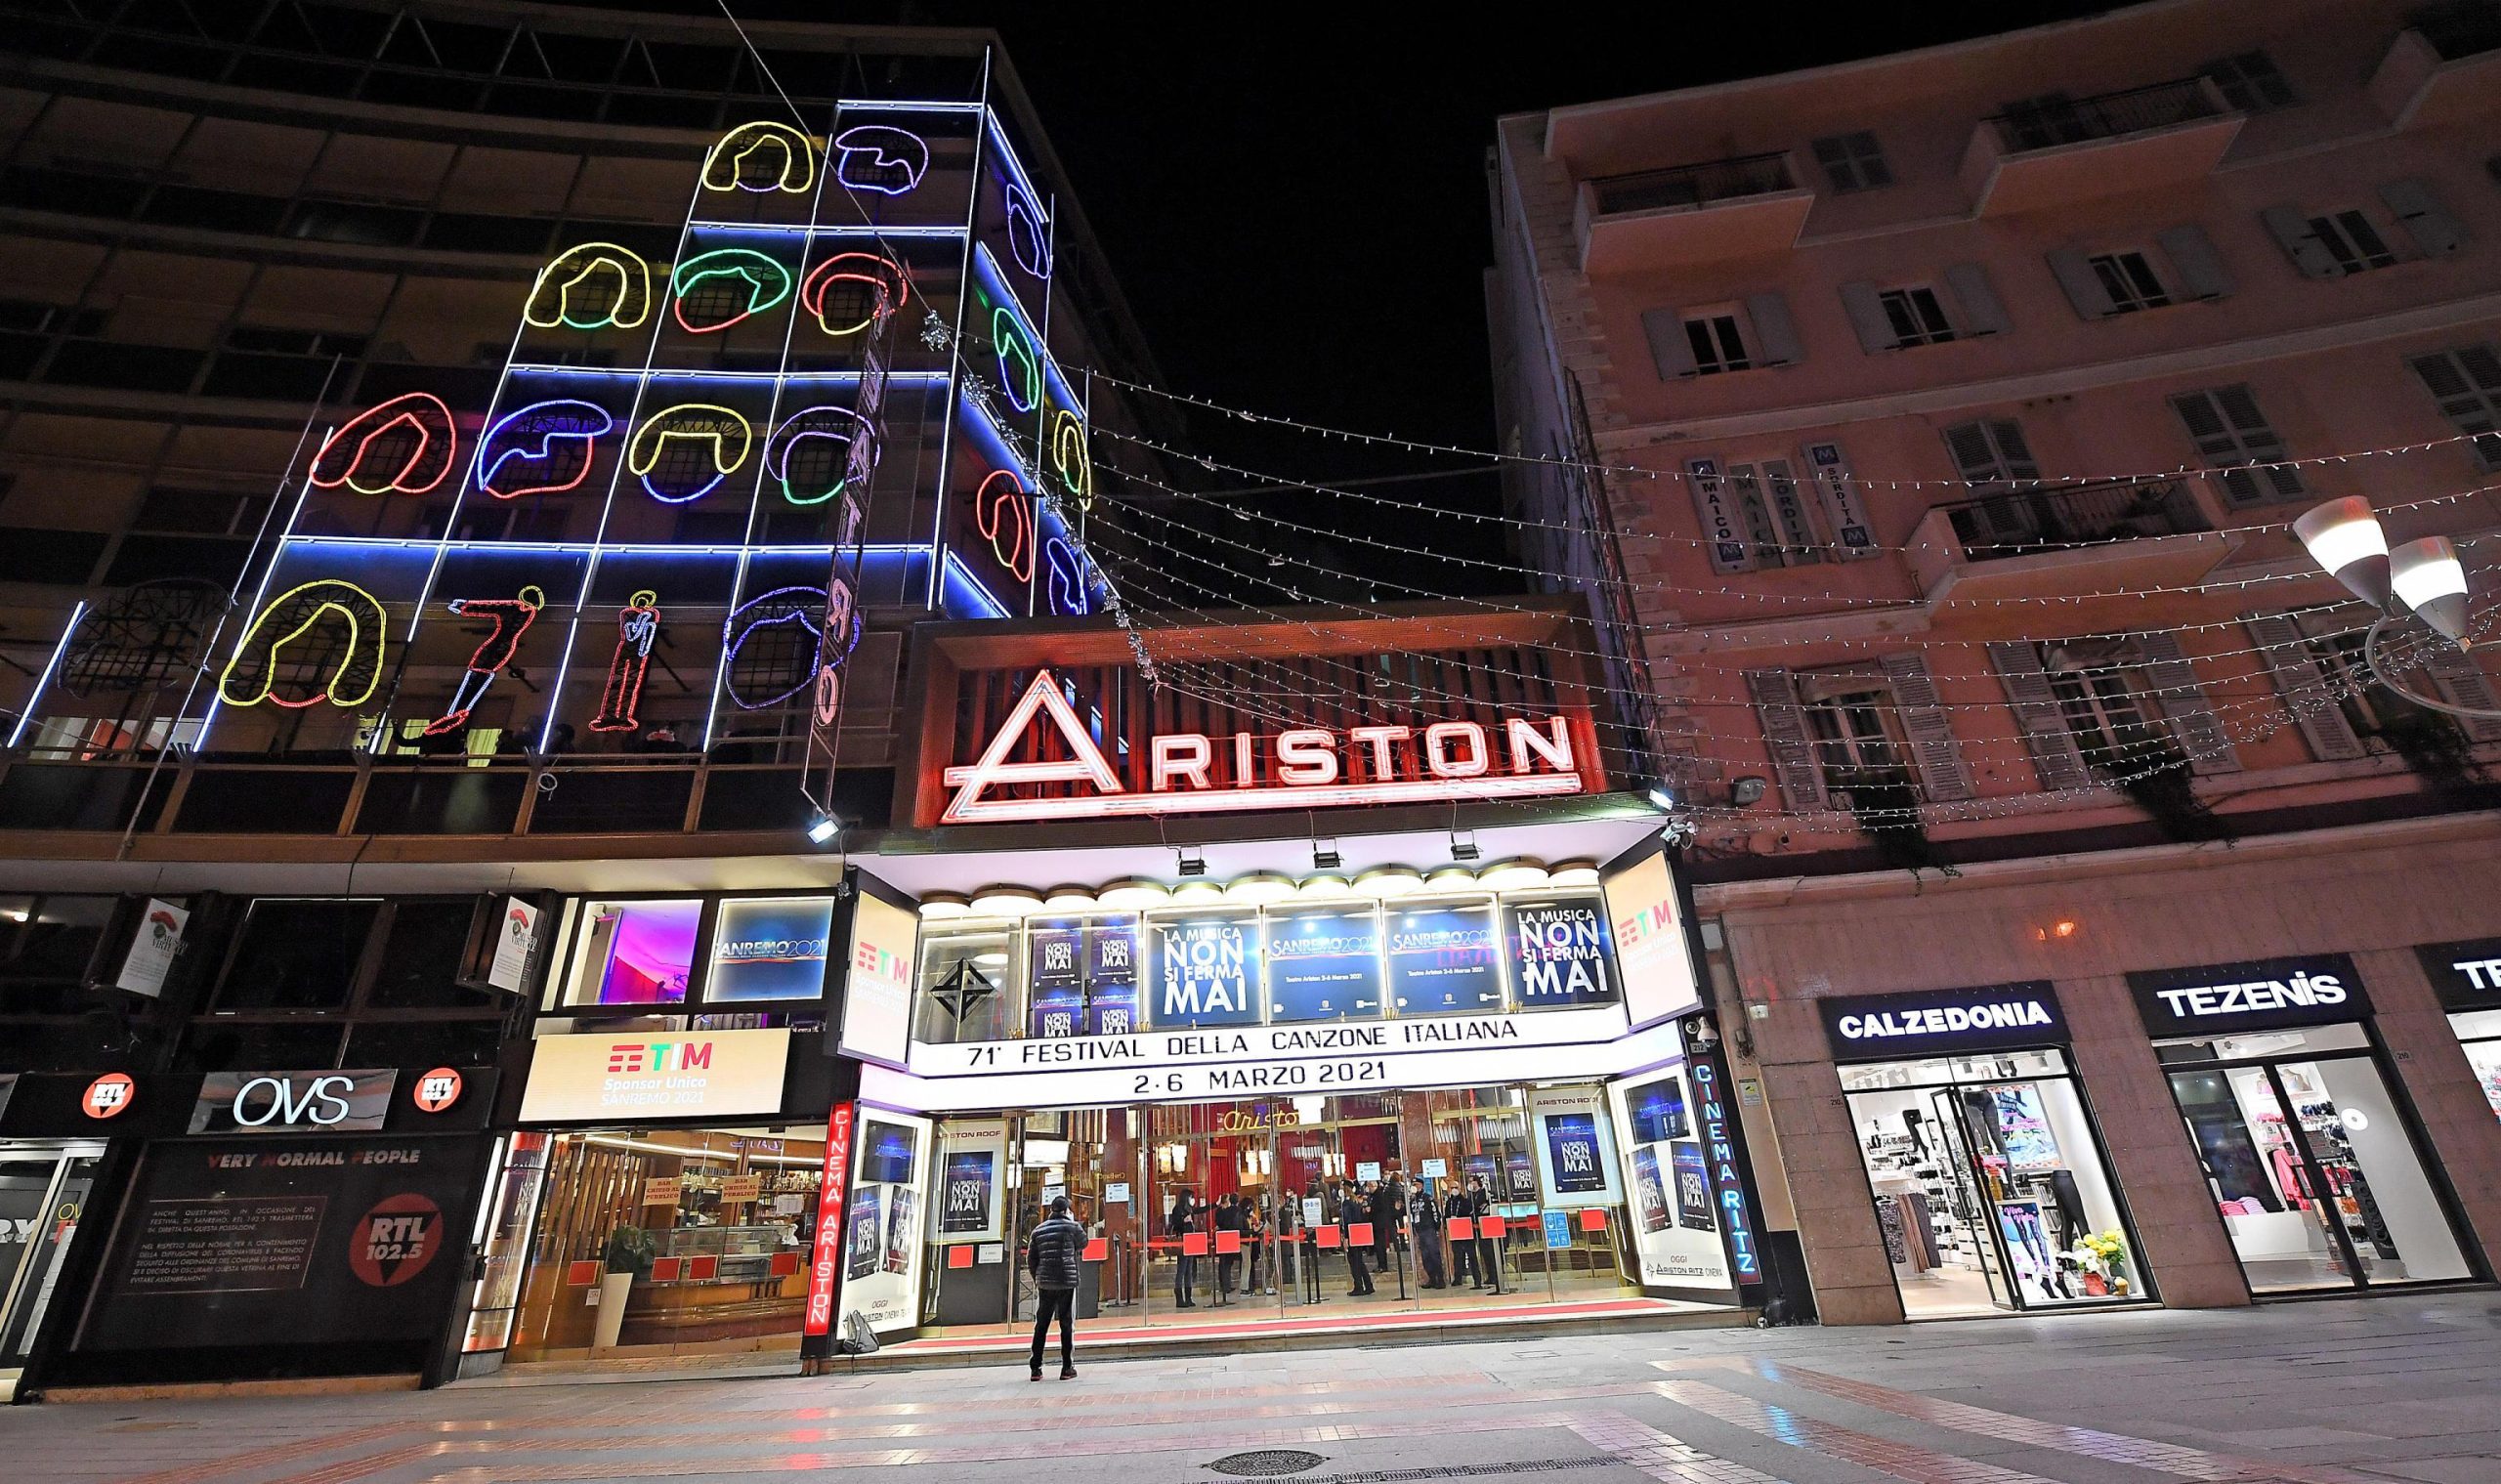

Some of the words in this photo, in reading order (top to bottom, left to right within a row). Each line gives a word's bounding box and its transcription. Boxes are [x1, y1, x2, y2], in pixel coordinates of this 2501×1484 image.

[1827, 467, 1855, 526] SORDITA
[1702, 482, 1731, 539] MAICO
[941, 668, 1582, 824] ARISTON
[1517, 911, 1540, 925] LA
[1542, 908, 1595, 922] MUSICA
[1635, 899, 1672, 937] TIM
[1163, 930, 1184, 943] LA
[1185, 926, 1243, 940] MUSICA
[1520, 920, 1600, 949] NON
[1045, 946, 1072, 956] NON
[1102, 943, 1128, 954] NON
[1163, 940, 1245, 967] NON
[1522, 948, 1540, 962] SI
[1542, 946, 1602, 961] FERMA
[878, 949, 909, 985] TIM
[1044, 956, 1072, 970] MAI
[1102, 954, 1128, 967] MAI
[1164, 966, 1183, 982] SI
[1183, 964, 1245, 980] FERMA
[1524, 960, 1608, 996] MAI
[1163, 978, 1247, 1015] MAI
[1044, 1015, 1072, 1026] NON
[1102, 1012, 1128, 1023] NON
[1839, 1000, 2053, 1039] CALZEDONIA
[1023, 1039, 1145, 1064] FESTIVAL
[1167, 1035, 1249, 1056] DELLA
[1272, 1026, 1386, 1051] CANZONE
[1404, 1019, 1518, 1043] ITALIANA
[649, 1041, 713, 1072] TIM
[603, 1077, 661, 1092] Sponsor
[665, 1075, 707, 1089] Unico
[1209, 1066, 1306, 1089] MARZO
[1319, 1061, 1385, 1082] 2021
[423, 1077, 458, 1092] RTL
[233, 1076, 354, 1126] OVS
[601, 1091, 669, 1106] SANREMO
[673, 1090, 704, 1104] 2021
[1536, 1098, 1577, 1107] ARISTON
[975, 1129, 1001, 1138] ROOF
[207, 1153, 258, 1168] VERY
[261, 1151, 345, 1167] NORMAL
[351, 1149, 421, 1166] PEOPLE
[826, 1110, 850, 1203] CINEMA
[1561, 1144, 1590, 1158] NON
[1564, 1158, 1593, 1172] MAI
[1696, 1064, 1736, 1182] CINEMA
[1724, 1190, 1756, 1273] RITZ
[952, 1185, 980, 1195] NON
[1514, 1179, 1534, 1189] MAI
[1682, 1176, 1702, 1190] NON
[950, 1198, 979, 1212] MAI
[1684, 1192, 1705, 1208] MAI
[369, 1217, 427, 1243] RTL
[858, 1225, 875, 1238] NON
[365, 1243, 424, 1261] 102.5
[856, 1238, 874, 1256] MAI
[810, 1213, 837, 1325] ARISTON
[871, 1299, 889, 1309] OGGI
